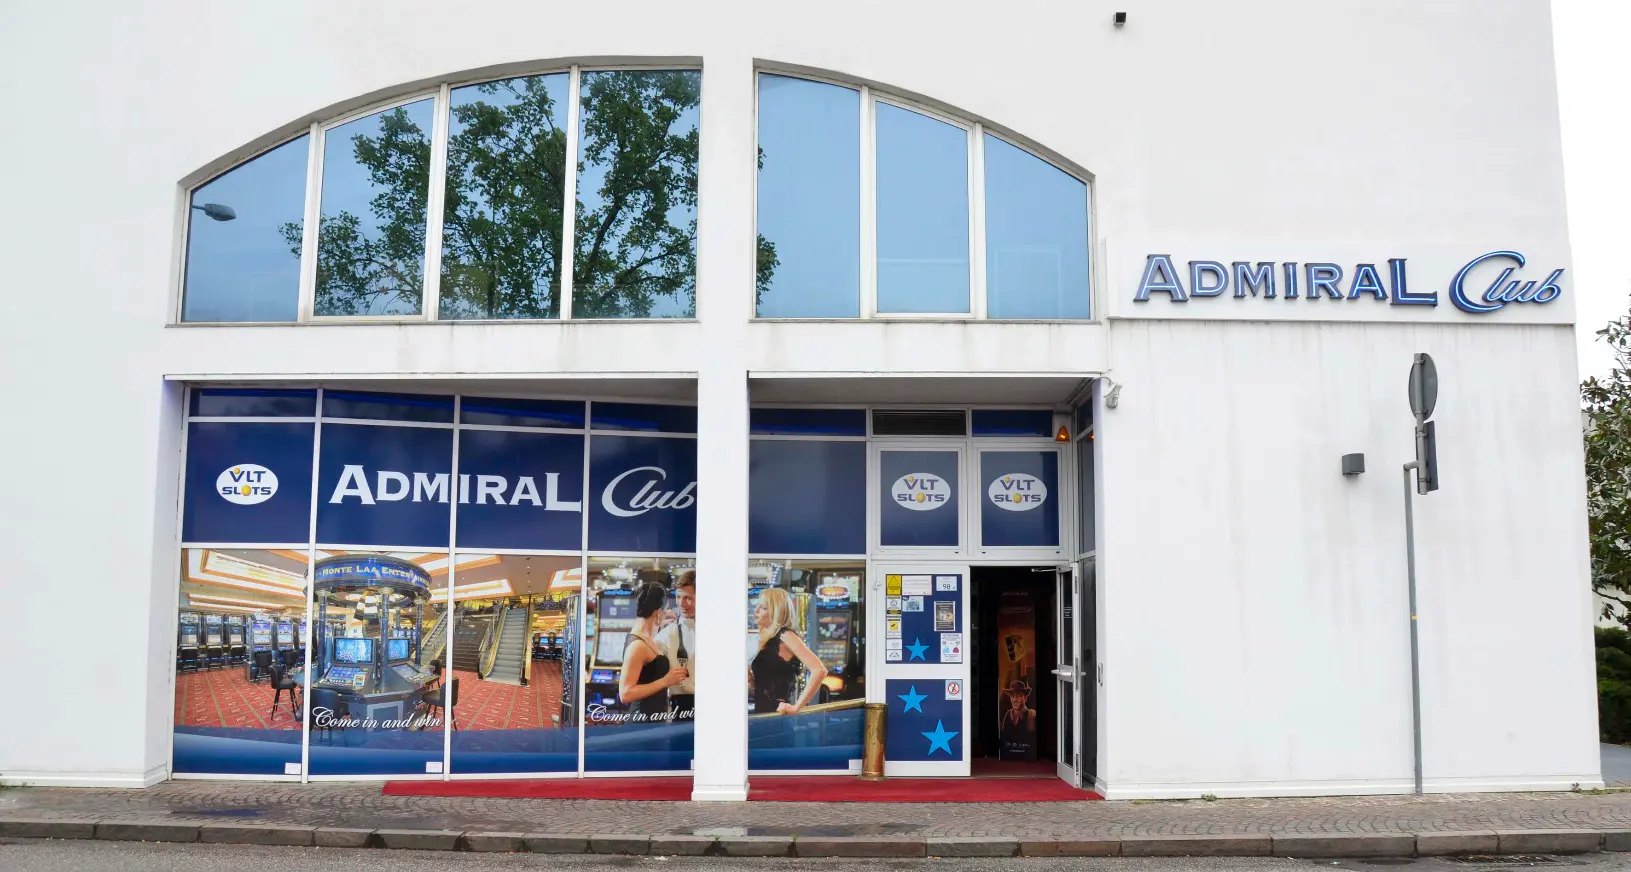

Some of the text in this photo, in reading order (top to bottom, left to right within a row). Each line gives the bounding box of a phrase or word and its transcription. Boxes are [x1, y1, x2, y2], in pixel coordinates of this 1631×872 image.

[1133, 250, 1565, 313] ADMIRAL Club
[229, 468, 266, 483] VLT
[222, 485, 272, 496] SLOTS
[328, 464, 697, 517] ADMIRAL Club
[903, 476, 939, 491] VLT
[1000, 476, 1035, 491] VLT
[897, 493, 945, 503] SLOTS
[994, 493, 1042, 503] SLOTS
[322, 566, 353, 576] MONTE
[312, 706, 360, 728] Come
[362, 717, 380, 728] in
[382, 713, 412, 728] and
[587, 703, 695, 722] Come in and wi
